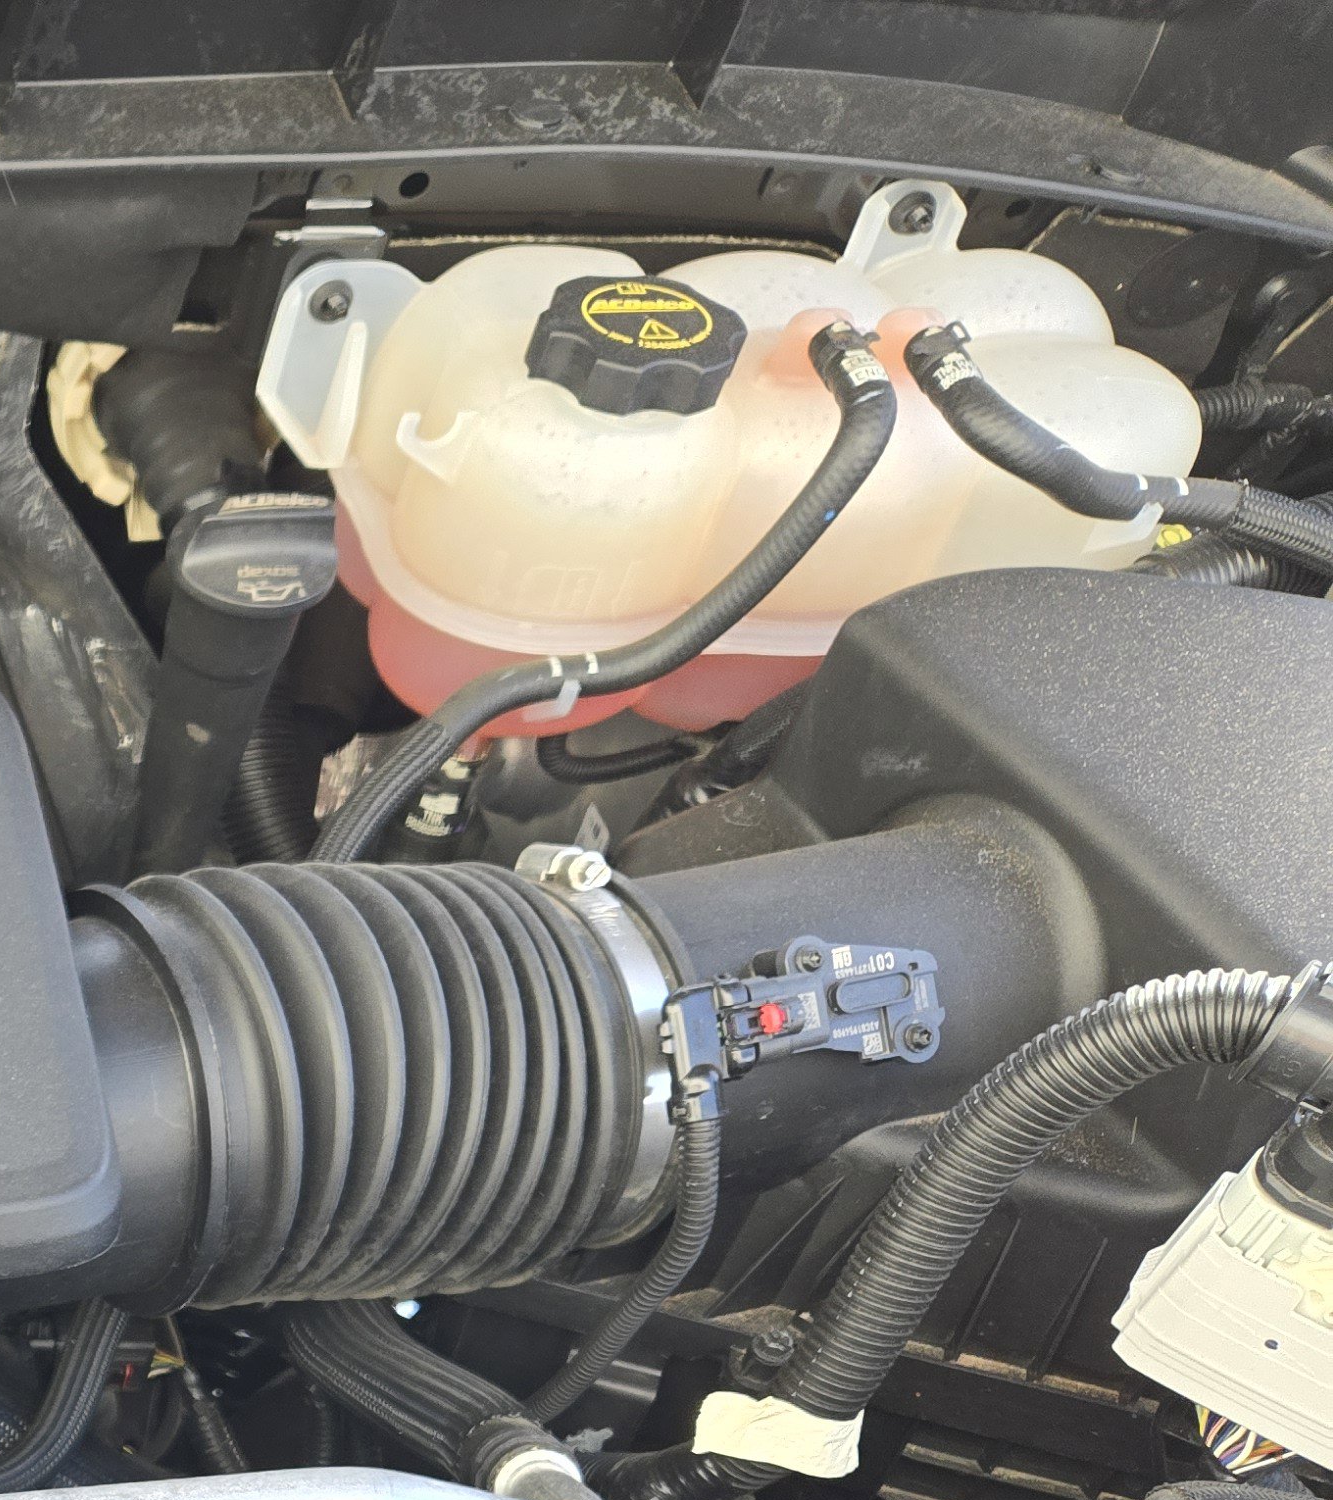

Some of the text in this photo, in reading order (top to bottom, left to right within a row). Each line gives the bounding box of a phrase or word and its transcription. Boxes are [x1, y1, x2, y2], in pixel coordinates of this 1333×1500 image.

[589, 299, 695, 314] ACDelco
[218, 493, 329, 513] ACDelco
[832, 951, 853, 970] GM
